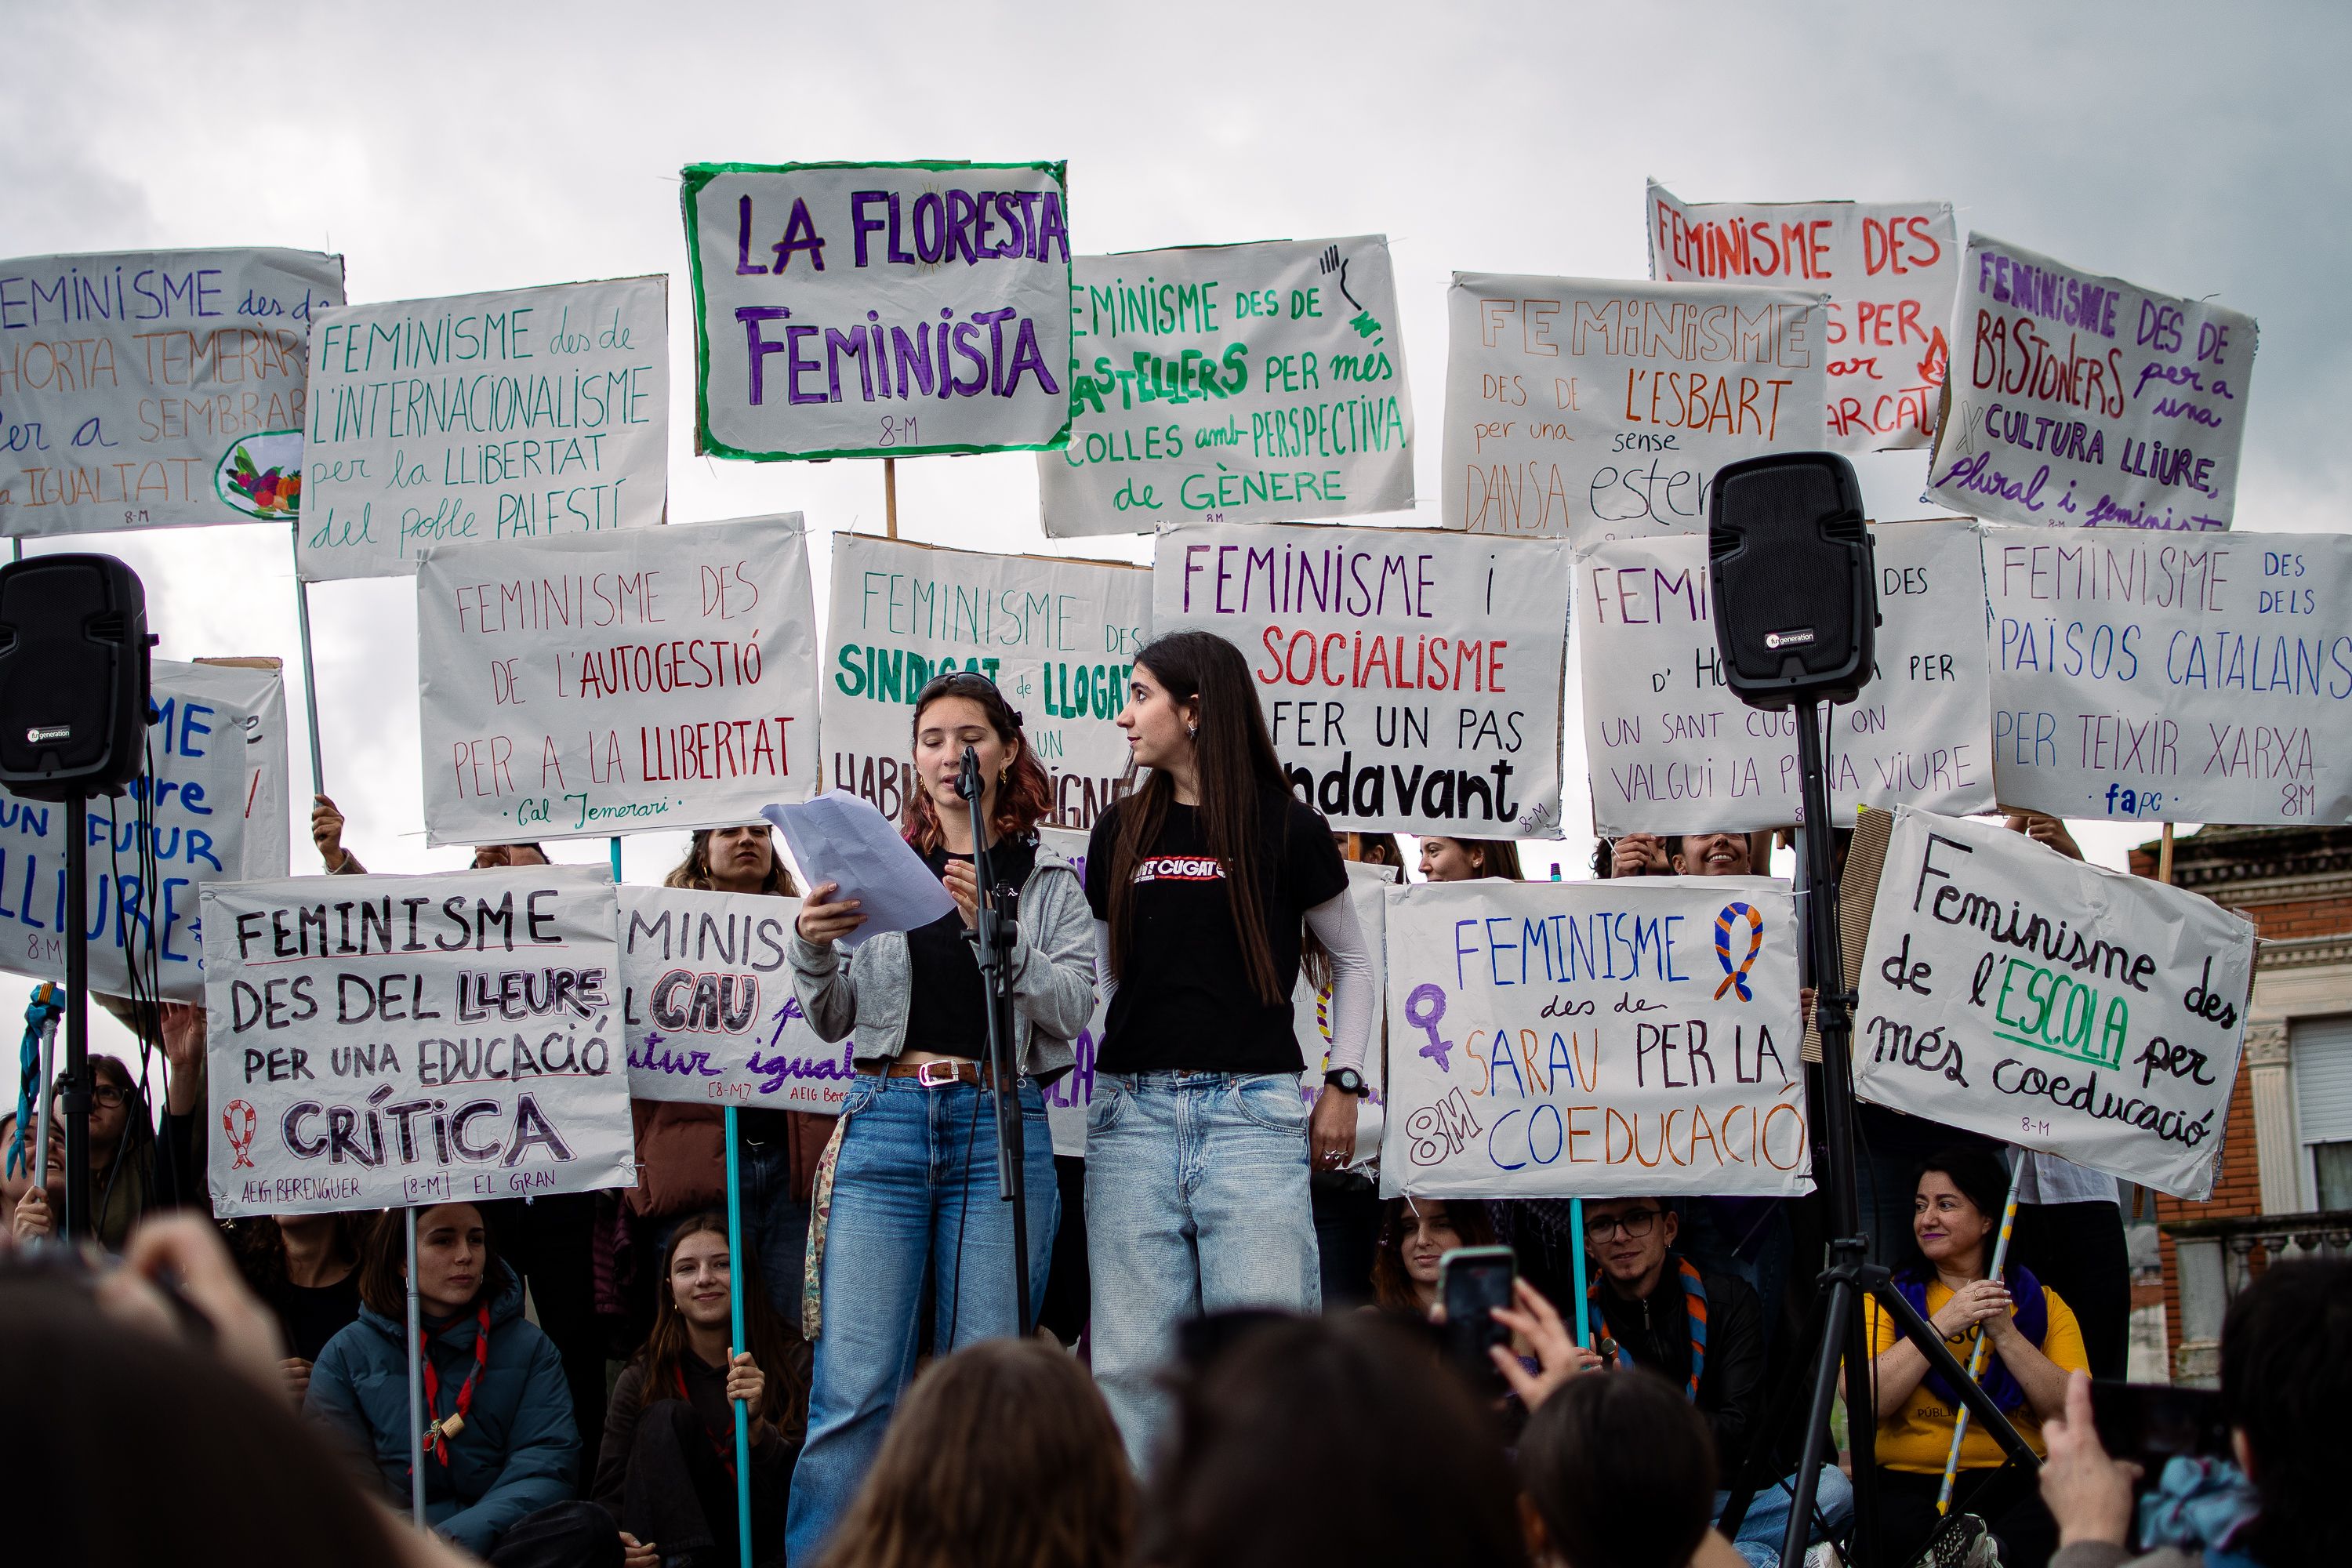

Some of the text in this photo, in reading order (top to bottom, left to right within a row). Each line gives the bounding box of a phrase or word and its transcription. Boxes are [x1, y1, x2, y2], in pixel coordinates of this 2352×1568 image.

[735, 189, 1070, 275] LA FLORESTA
[1657, 199, 1940, 279] FEMINISME DES
[1, 266, 223, 328] EMINISME
[238, 289, 285, 315] des
[1235, 289, 1279, 320] DES
[1290, 288, 1323, 321] DE
[1857, 299, 1929, 345] PER
[1978, 252, 2228, 364] FEMINISME DES DE
[132, 321, 309, 384] TEMERÀR
[321, 306, 634, 372] FEMINISME des de
[735, 305, 1060, 405] FEMINISTA
[1265, 351, 1319, 393] PER
[1330, 337, 1392, 383] més
[1480, 299, 1810, 368] FEMINISME
[1973, 308, 2234, 419] BASTONERS per a
[1827, 358, 1882, 380] ar
[0, 389, 306, 452] er a SEMBRAR
[313, 366, 652, 444] L'INTERNACIONALISME
[878, 415, 918, 447] 8-M
[1195, 415, 1247, 448] amb
[1251, 394, 1406, 459] PERSPECTIVA
[1483, 368, 1793, 441] DES DE L'ESBART
[1827, 387, 1933, 436] ARCAT
[1985, 404, 2103, 464] CULTURA
[2152, 397, 2222, 428] una
[1474, 422, 1679, 454] per una sense
[311, 434, 607, 511] per la LLIBERTAT
[1113, 463, 1346, 511] de GÈNERE
[1465, 461, 1569, 532] DANSA
[1935, 451, 2050, 512] plural
[2058, 480, 2076, 513] i
[125, 510, 148, 523] 8-M
[308, 503, 377, 548] del
[456, 561, 759, 633] FEMINISME DES
[1183, 543, 1435, 618] FEMINISME
[1592, 566, 1928, 624] FEMI DES
[2004, 539, 2305, 612] FEMINISME DES
[2259, 590, 2315, 614] DELS
[863, 572, 1144, 654] FEMINISME DES
[491, 629, 762, 706] DE L'AUTOGESTIÓ
[1016, 675, 1032, 699] de
[1258, 626, 1508, 692] SOCIALISME
[1910, 654, 1955, 681] PER
[2002, 618, 2352, 699] PAÏSOS CATALANS
[1036, 730, 1063, 759] UN
[1272, 701, 1524, 753] FER UN PAS
[1601, 704, 1886, 747] UN SANT CUGT ON
[1995, 710, 2314, 779] PER TEIXIR XARXA
[453, 717, 795, 798] PER A LA LLIBERTAT
[1283, 751, 1519, 822] ndavant
[1610, 757, 1712, 803] VALGUI
[1731, 754, 1761, 797] LA
[1875, 745, 1976, 793] VIURE
[129, 775, 212, 815] re
[518, 798, 552, 826] Cal
[835, 752, 1134, 829] HABI IGN
[1518, 802, 1551, 833] 8-M
[1157, 859, 1217, 877] CUGAT
[27, 934, 63, 964] 8-M
[236, 889, 563, 960] FEMINISME
[627, 909, 785, 972] MINIS
[1455, 911, 1690, 990] FEMINISME
[1914, 833, 2238, 1030] Feminisme des
[231, 975, 318, 1033] DES
[336, 973, 441, 1025] DEL
[455, 967, 610, 1025] LLEURE
[650, 969, 760, 1035] CAU
[1540, 992, 1668, 1019] des de
[1881, 934, 2216, 1089] de l'ESCOLA per
[244, 1015, 609, 1085] PER UNA EDUCACIÓ
[627, 1031, 728, 1076] utur
[1465, 1019, 1788, 1098] SARAU PER LA
[1867, 1015, 2214, 1147] més coeducació
[790, 1087, 818, 1101] AEIG
[281, 1084, 577, 1171] CRÍTICA
[1406, 1083, 1806, 1171] 8M COEDUCACIÓ
[2022, 1116, 2050, 1137] 8-M
[276, 1178, 361, 1203] BERENGUER
[474, 1177, 496, 1194] EL
[510, 1172, 556, 1192] GRAN
